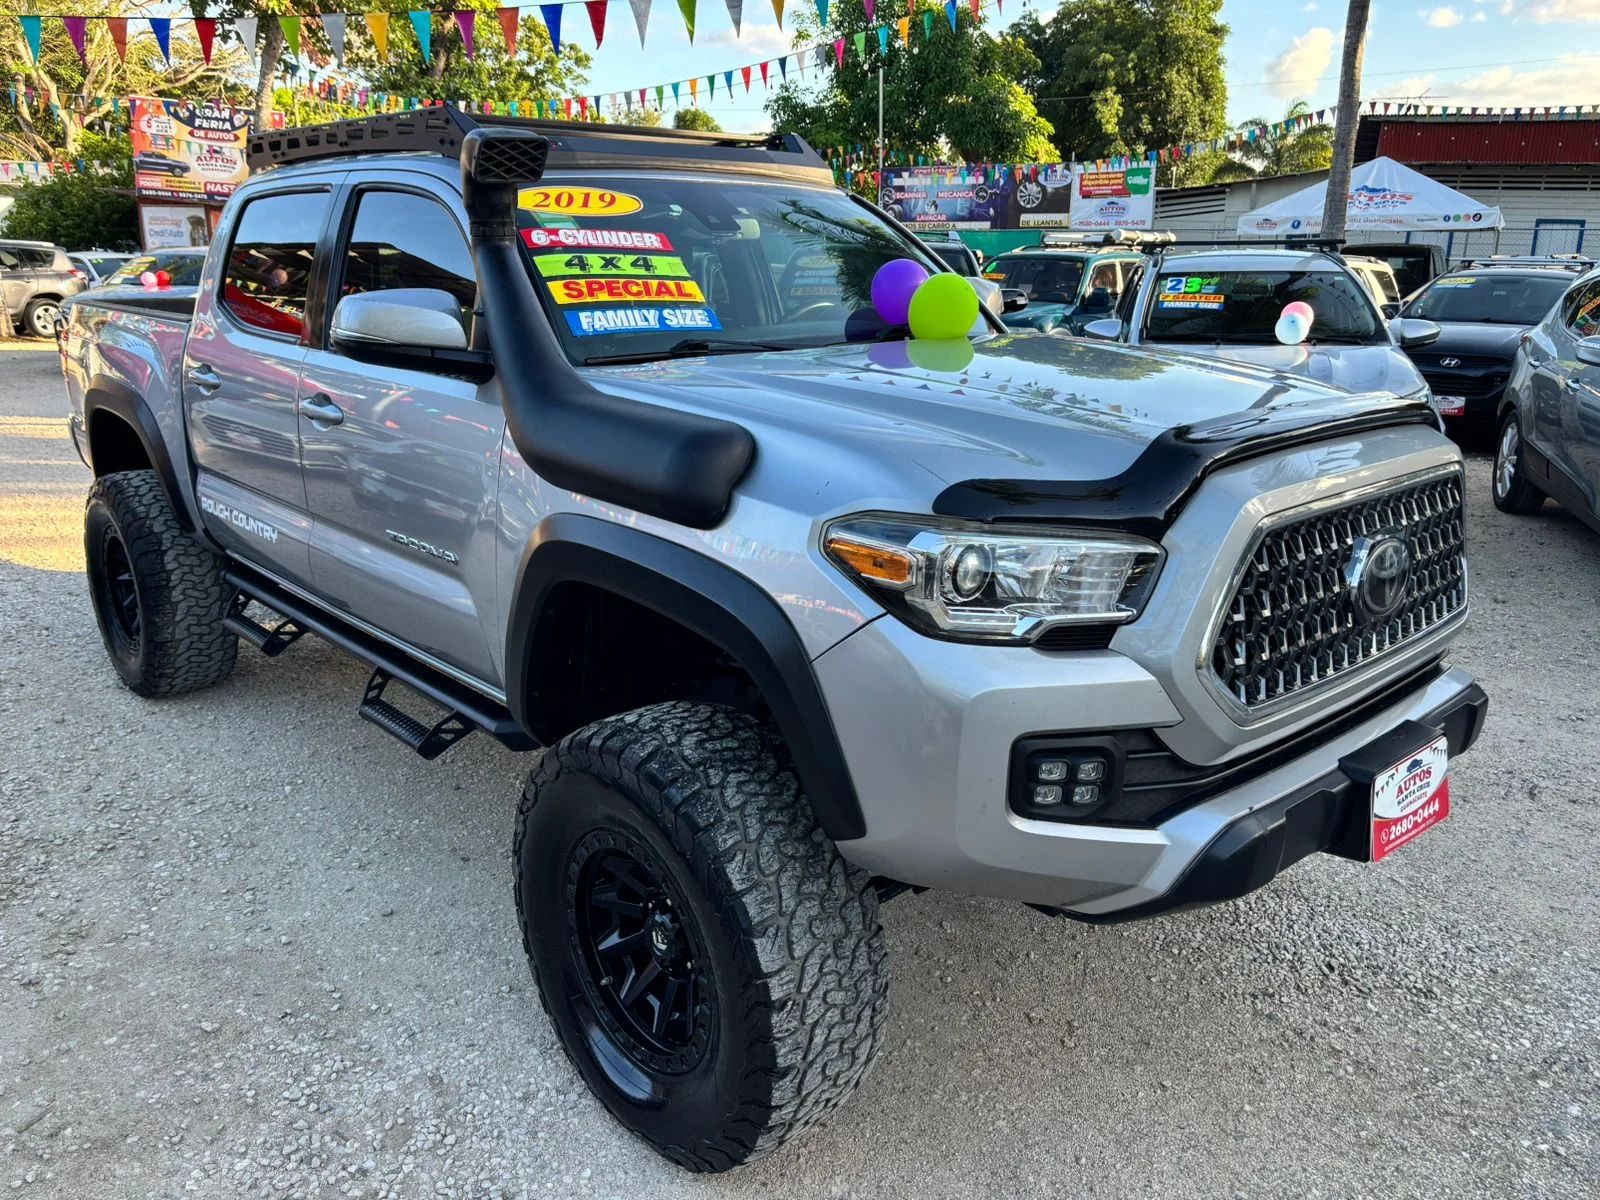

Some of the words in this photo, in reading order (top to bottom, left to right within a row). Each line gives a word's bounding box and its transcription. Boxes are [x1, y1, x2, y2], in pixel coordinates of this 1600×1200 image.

[195, 118, 232, 130] FERIA
[207, 131, 236, 141] AUTOS
[205, 182, 237, 194] HAST
[532, 191, 617, 209] 2019
[927, 222, 951, 230] CARRO
[530, 229, 663, 249] 6-CYLINDER
[563, 280, 696, 299] SPECIAL
[578, 309, 661, 332] FAMILY
[662, 308, 713, 328] SIZE
[200, 496, 231, 521] ROUGH
[231, 509, 278, 544] COUNTRY
[385, 528, 459, 566] TACOMA
[1395, 766, 1433, 799] AUTOS
[1389, 797, 1440, 841] 2680-0444
